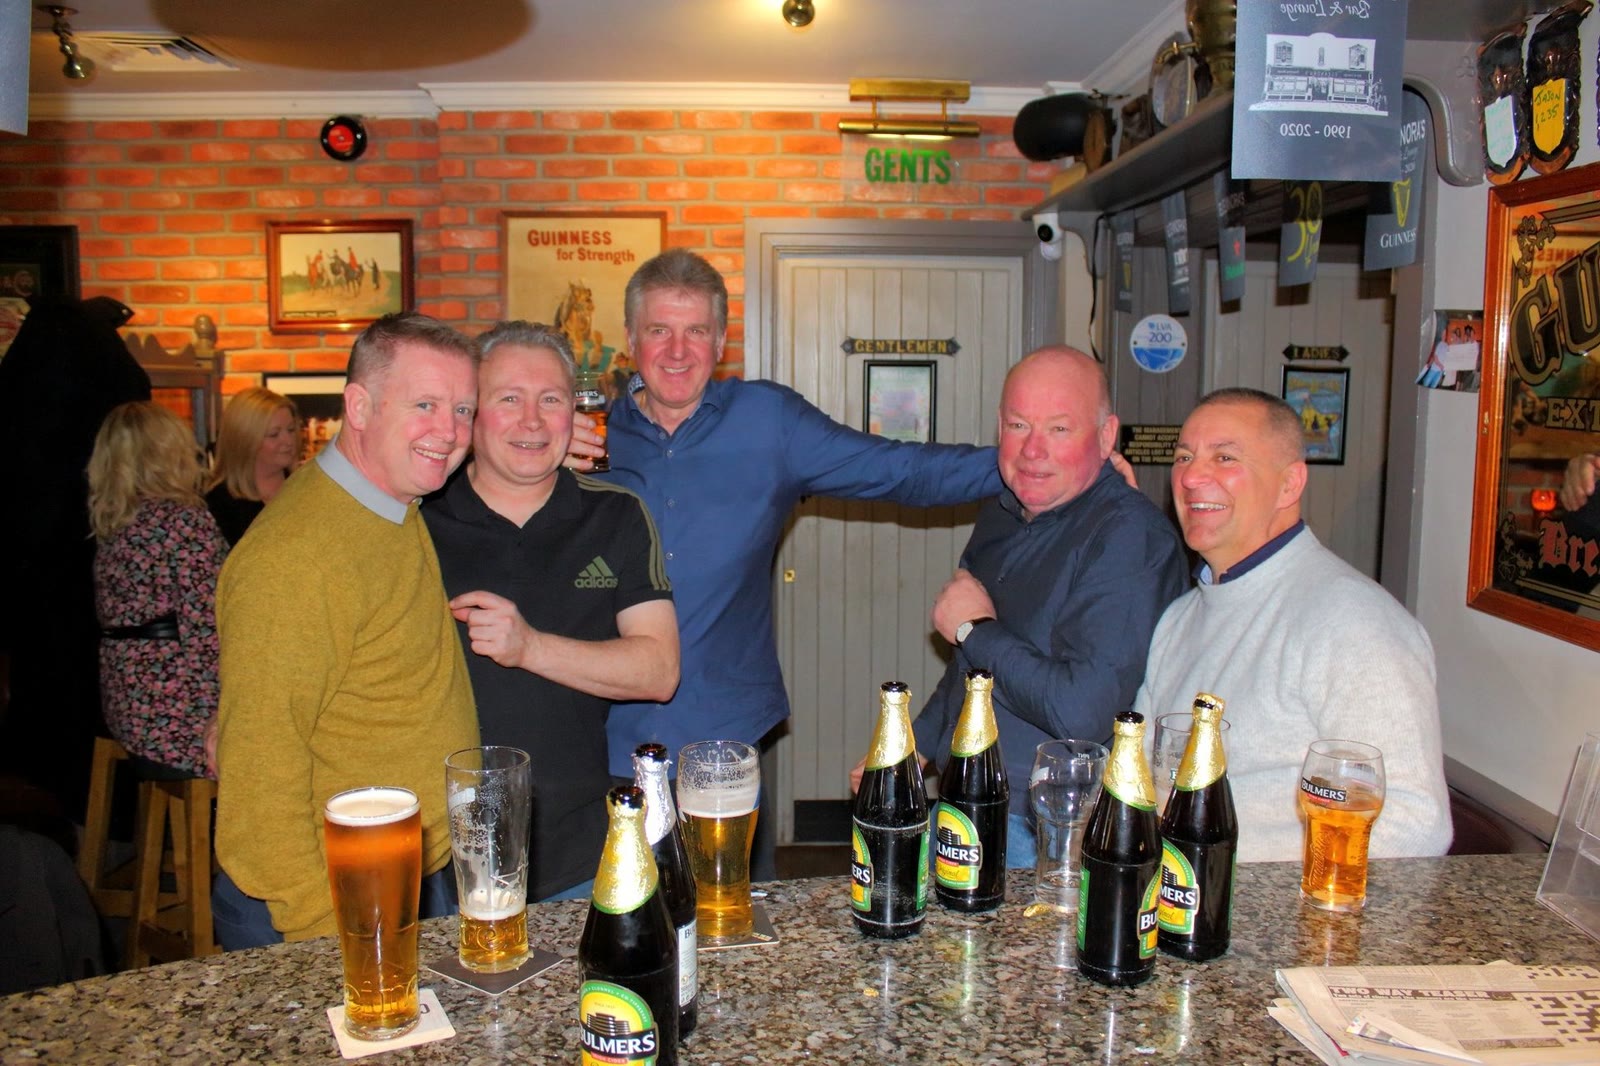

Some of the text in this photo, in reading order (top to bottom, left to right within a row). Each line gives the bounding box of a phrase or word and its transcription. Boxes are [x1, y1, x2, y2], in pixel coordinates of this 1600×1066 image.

[865, 148, 951, 184] GENTS
[528, 229, 613, 247] GUINNESS
[556, 248, 635, 265] for Strength
[1149, 331, 1172, 343] 200
[854, 339, 948, 354] GENTLEMEN
[1293, 347, 1340, 360] LADIES
[576, 390, 598, 398] LMERS
[574, 576, 618, 588] adidas
[1301, 780, 1345, 801] BULMERS
[938, 842, 979, 862] LMERS
[1330, 987, 1490, 998] TWO WAY TEASER
